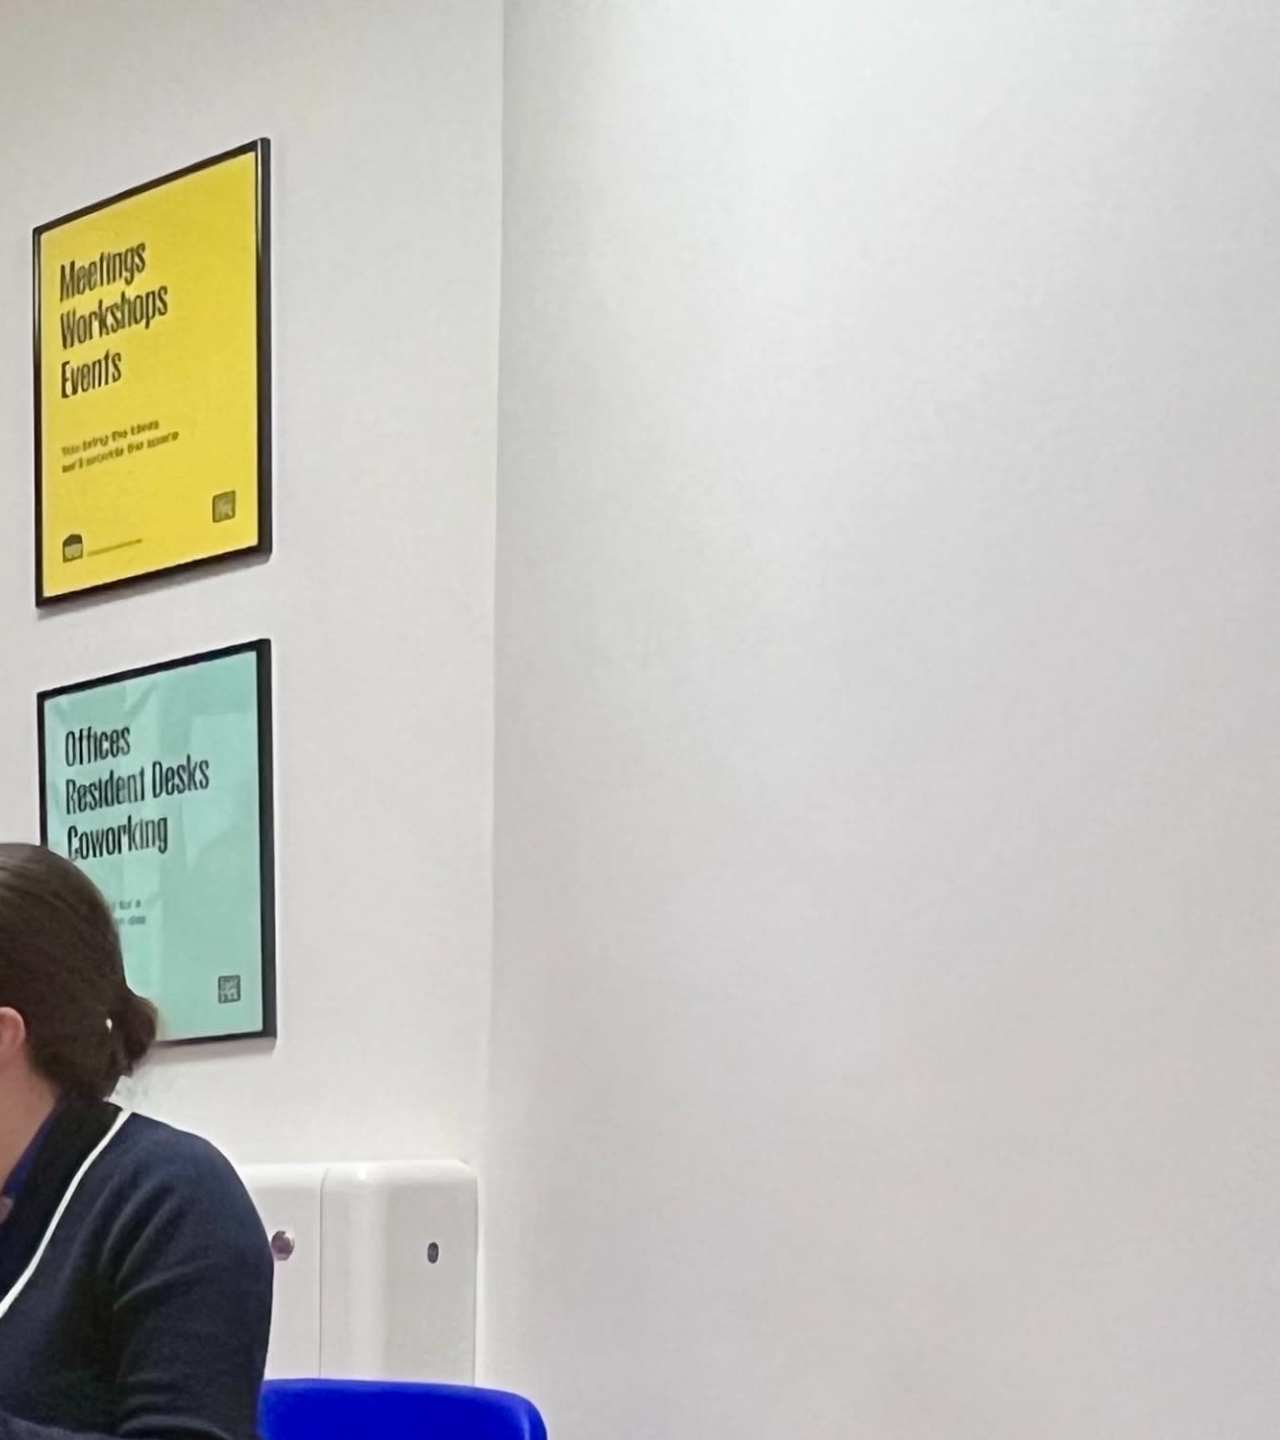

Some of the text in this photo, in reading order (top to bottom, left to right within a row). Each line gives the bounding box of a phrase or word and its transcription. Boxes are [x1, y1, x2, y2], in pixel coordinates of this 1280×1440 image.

[59, 242, 146, 303] Meetings
[59, 285, 168, 350] Workshops
[60, 349, 122, 399] Events
[64, 726, 131, 768] Offices
[66, 753, 209, 816] Resident Desks
[67, 814, 168, 862] Coworking
